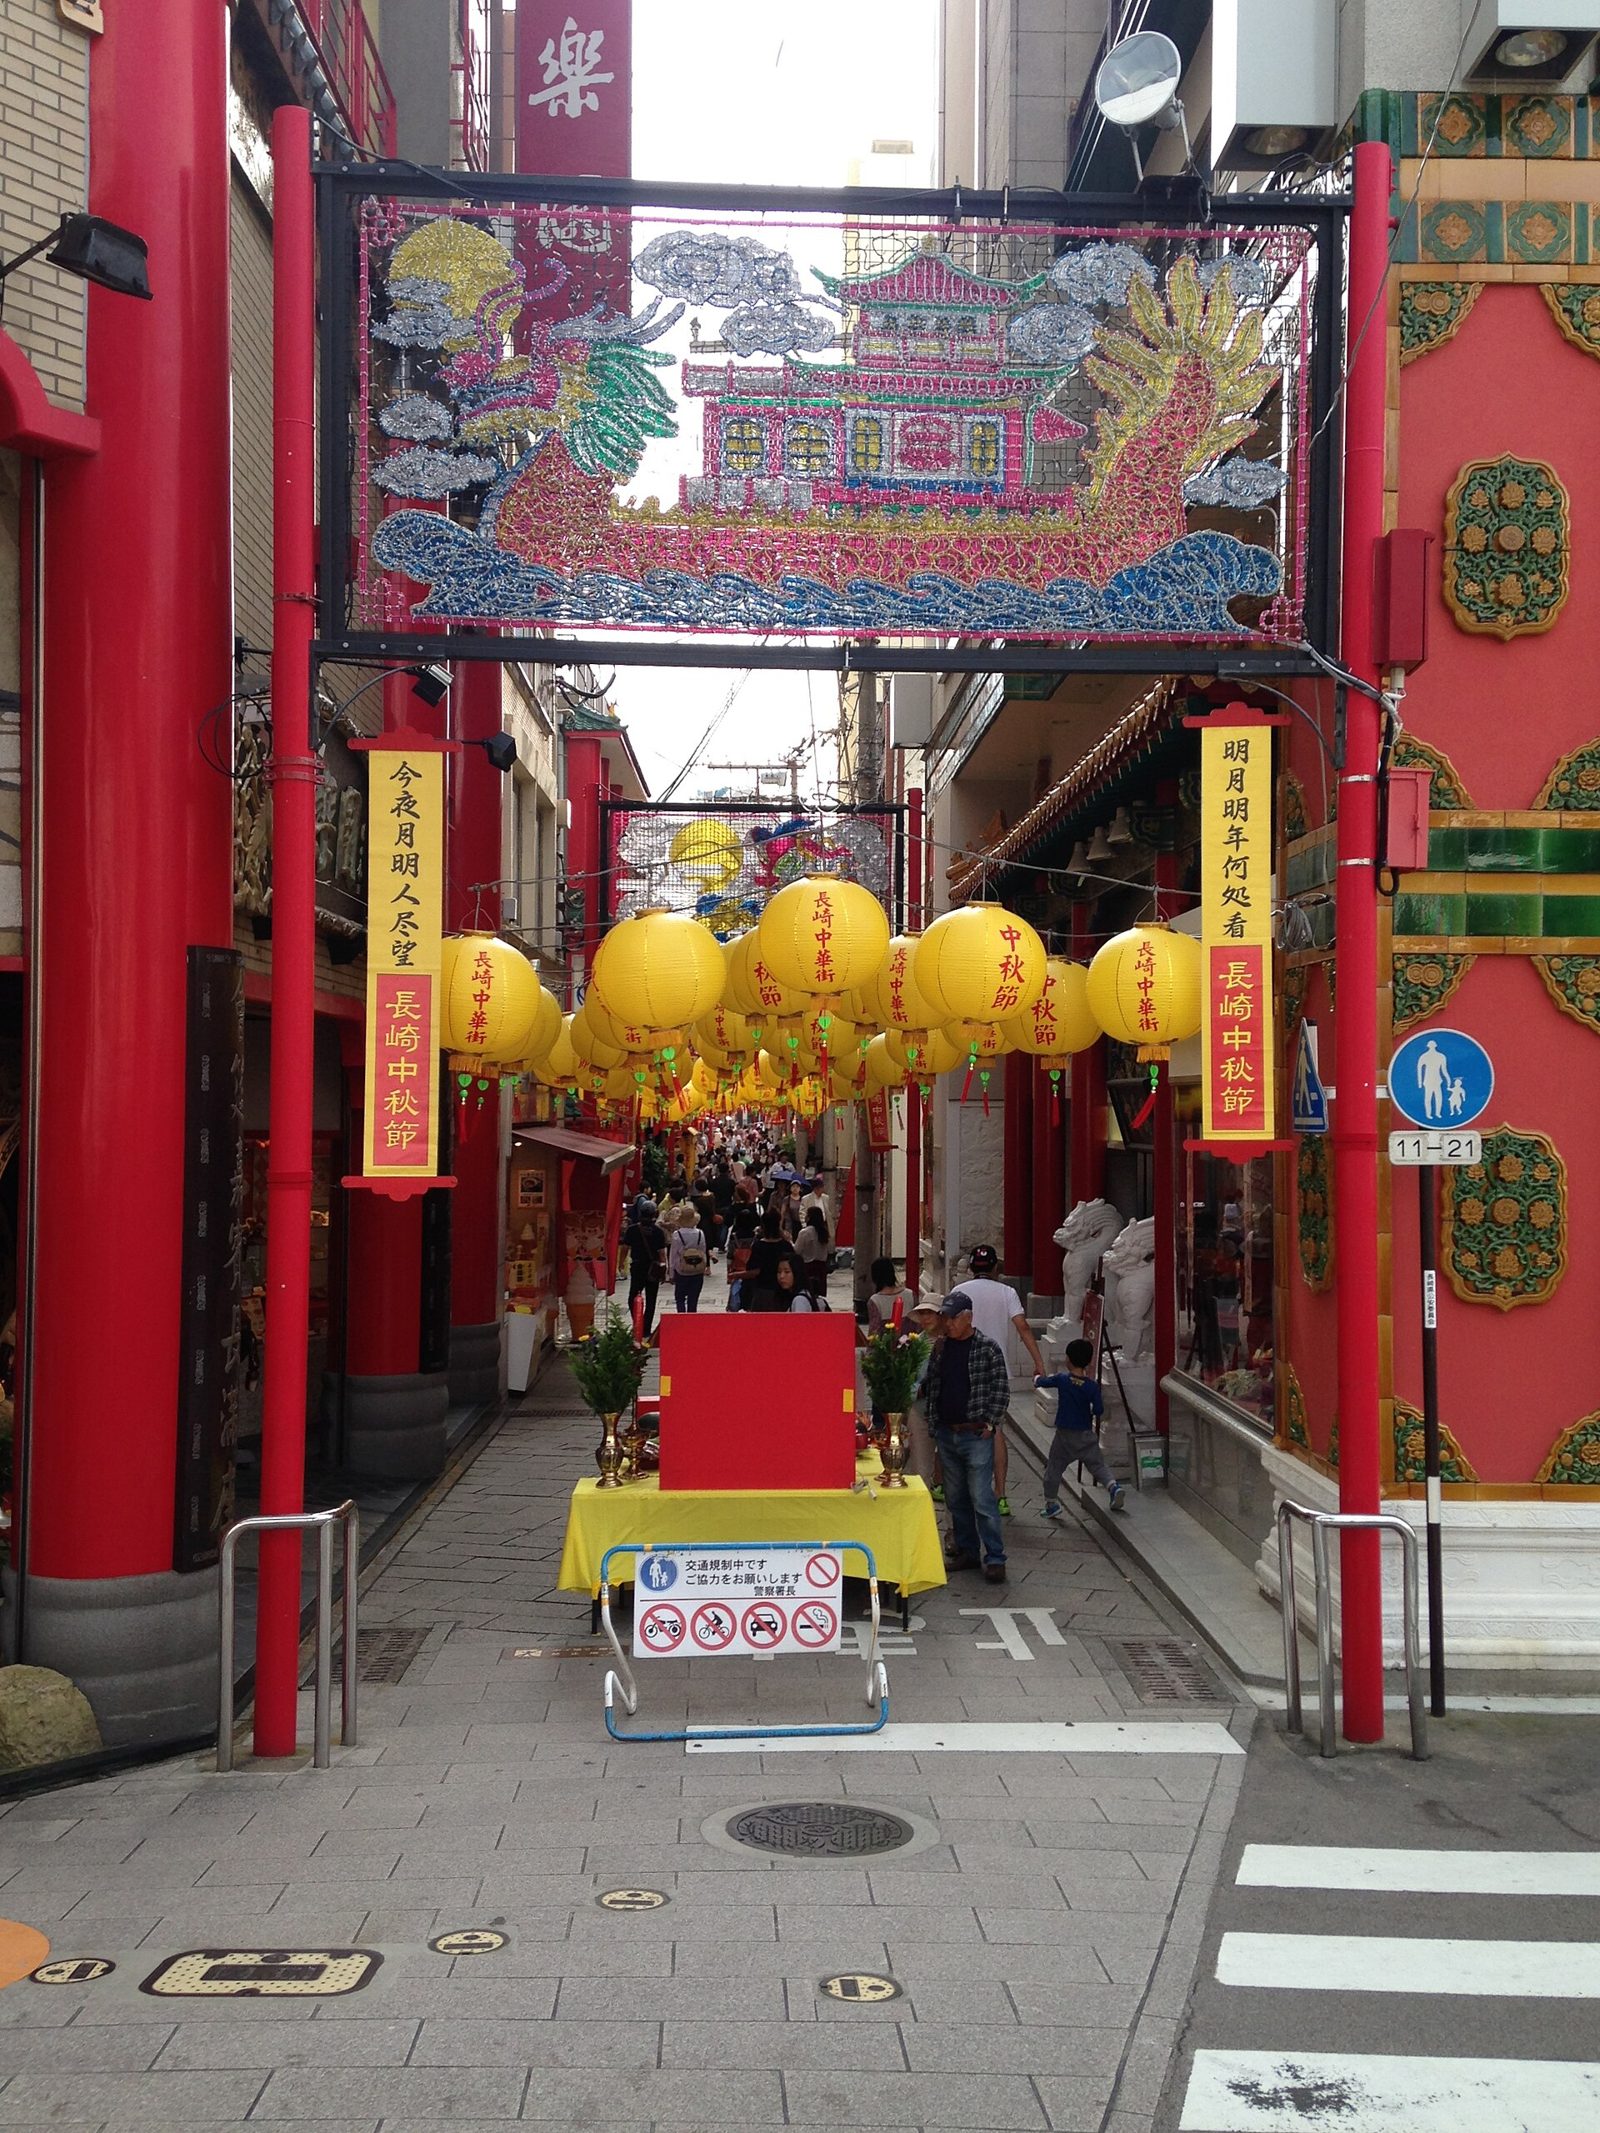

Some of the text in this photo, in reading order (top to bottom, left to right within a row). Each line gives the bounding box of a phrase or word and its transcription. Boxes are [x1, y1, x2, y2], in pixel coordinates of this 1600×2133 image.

[389, 760, 422, 967] 今夜月明人尽望
[812, 891, 836, 983] 長崎中華街
[991, 924, 1025, 1011] 中秋節
[465, 951, 495, 1045] 長崎中華街
[889, 948, 909, 1023] 長崎中華街
[1134, 941, 1160, 1032] 長崎中華街
[383, 990, 423, 1150] 長崎中秋節
[1218, 960, 1255, 1116] 長崎中秋節
[1396, 1138, 1475, 1158] 11-21
[685, 1559, 767, 1571] 交通規制中です
[685, 1573, 802, 1585] ご協力をお願いします
[753, 1586, 796, 1596] 警察署長
